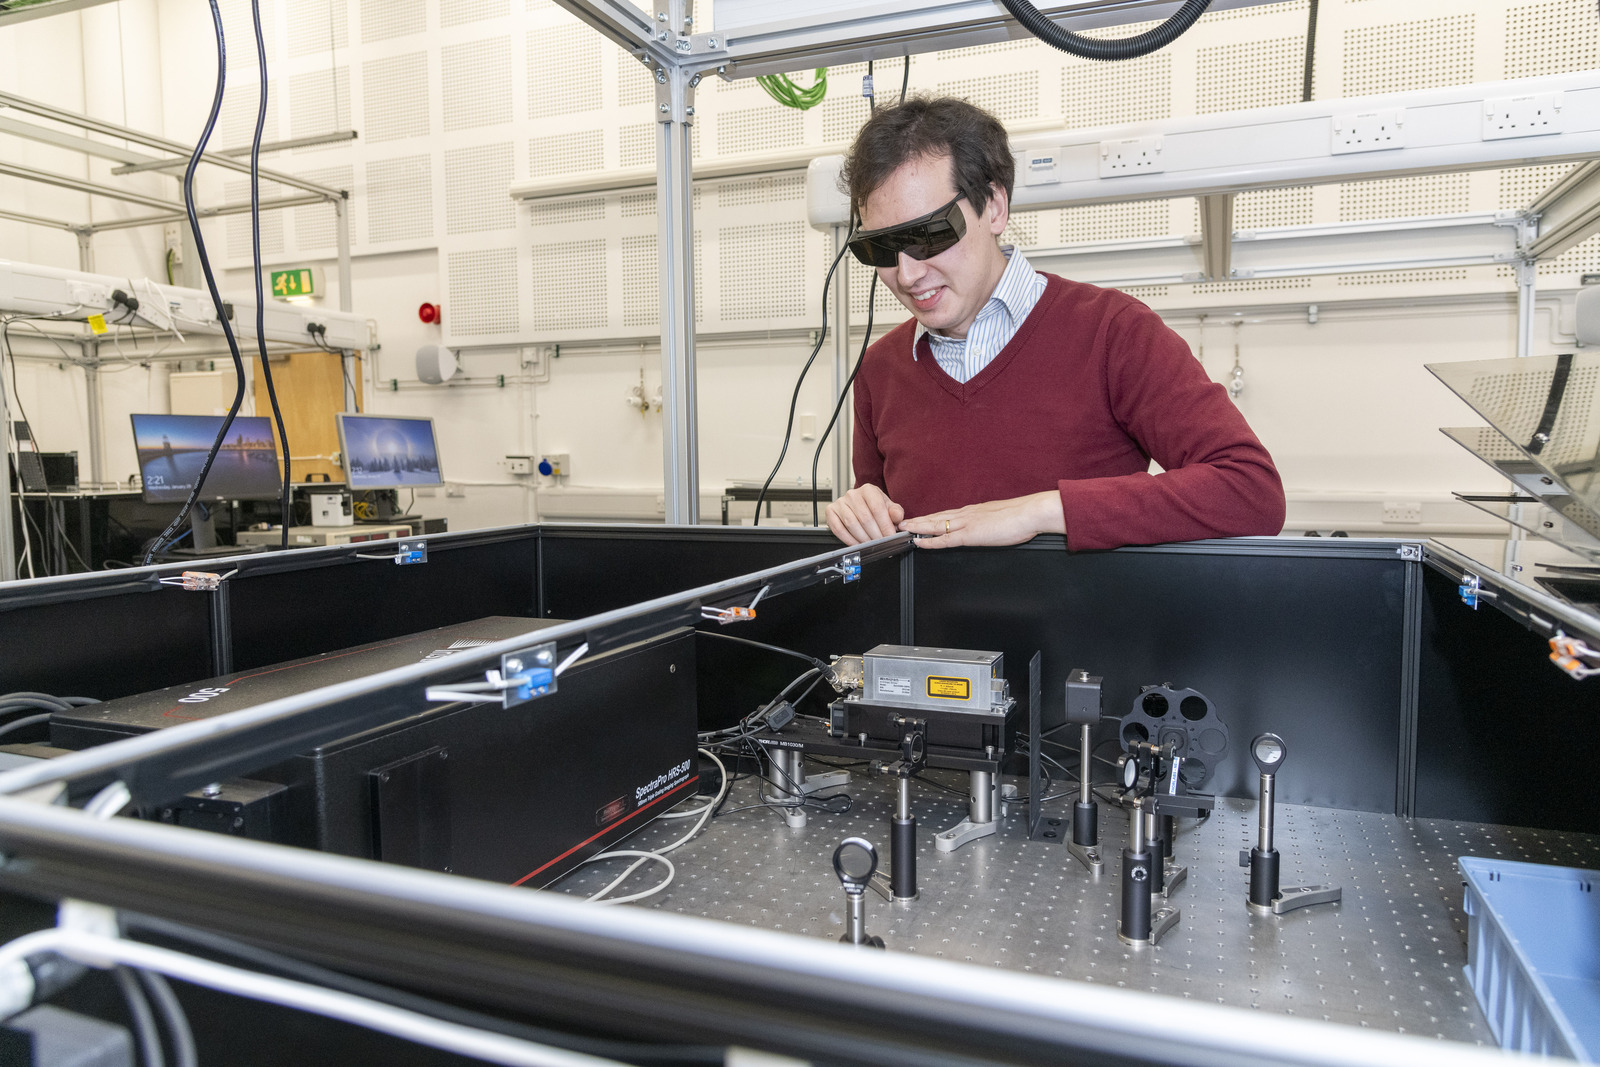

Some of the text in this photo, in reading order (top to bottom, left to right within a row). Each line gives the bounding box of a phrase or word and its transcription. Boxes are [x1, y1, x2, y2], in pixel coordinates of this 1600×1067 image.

[147, 476, 164, 485] 2:21
[178, 688, 231, 702] 500
[636, 758, 690, 799] SpectraPro HRS-500
